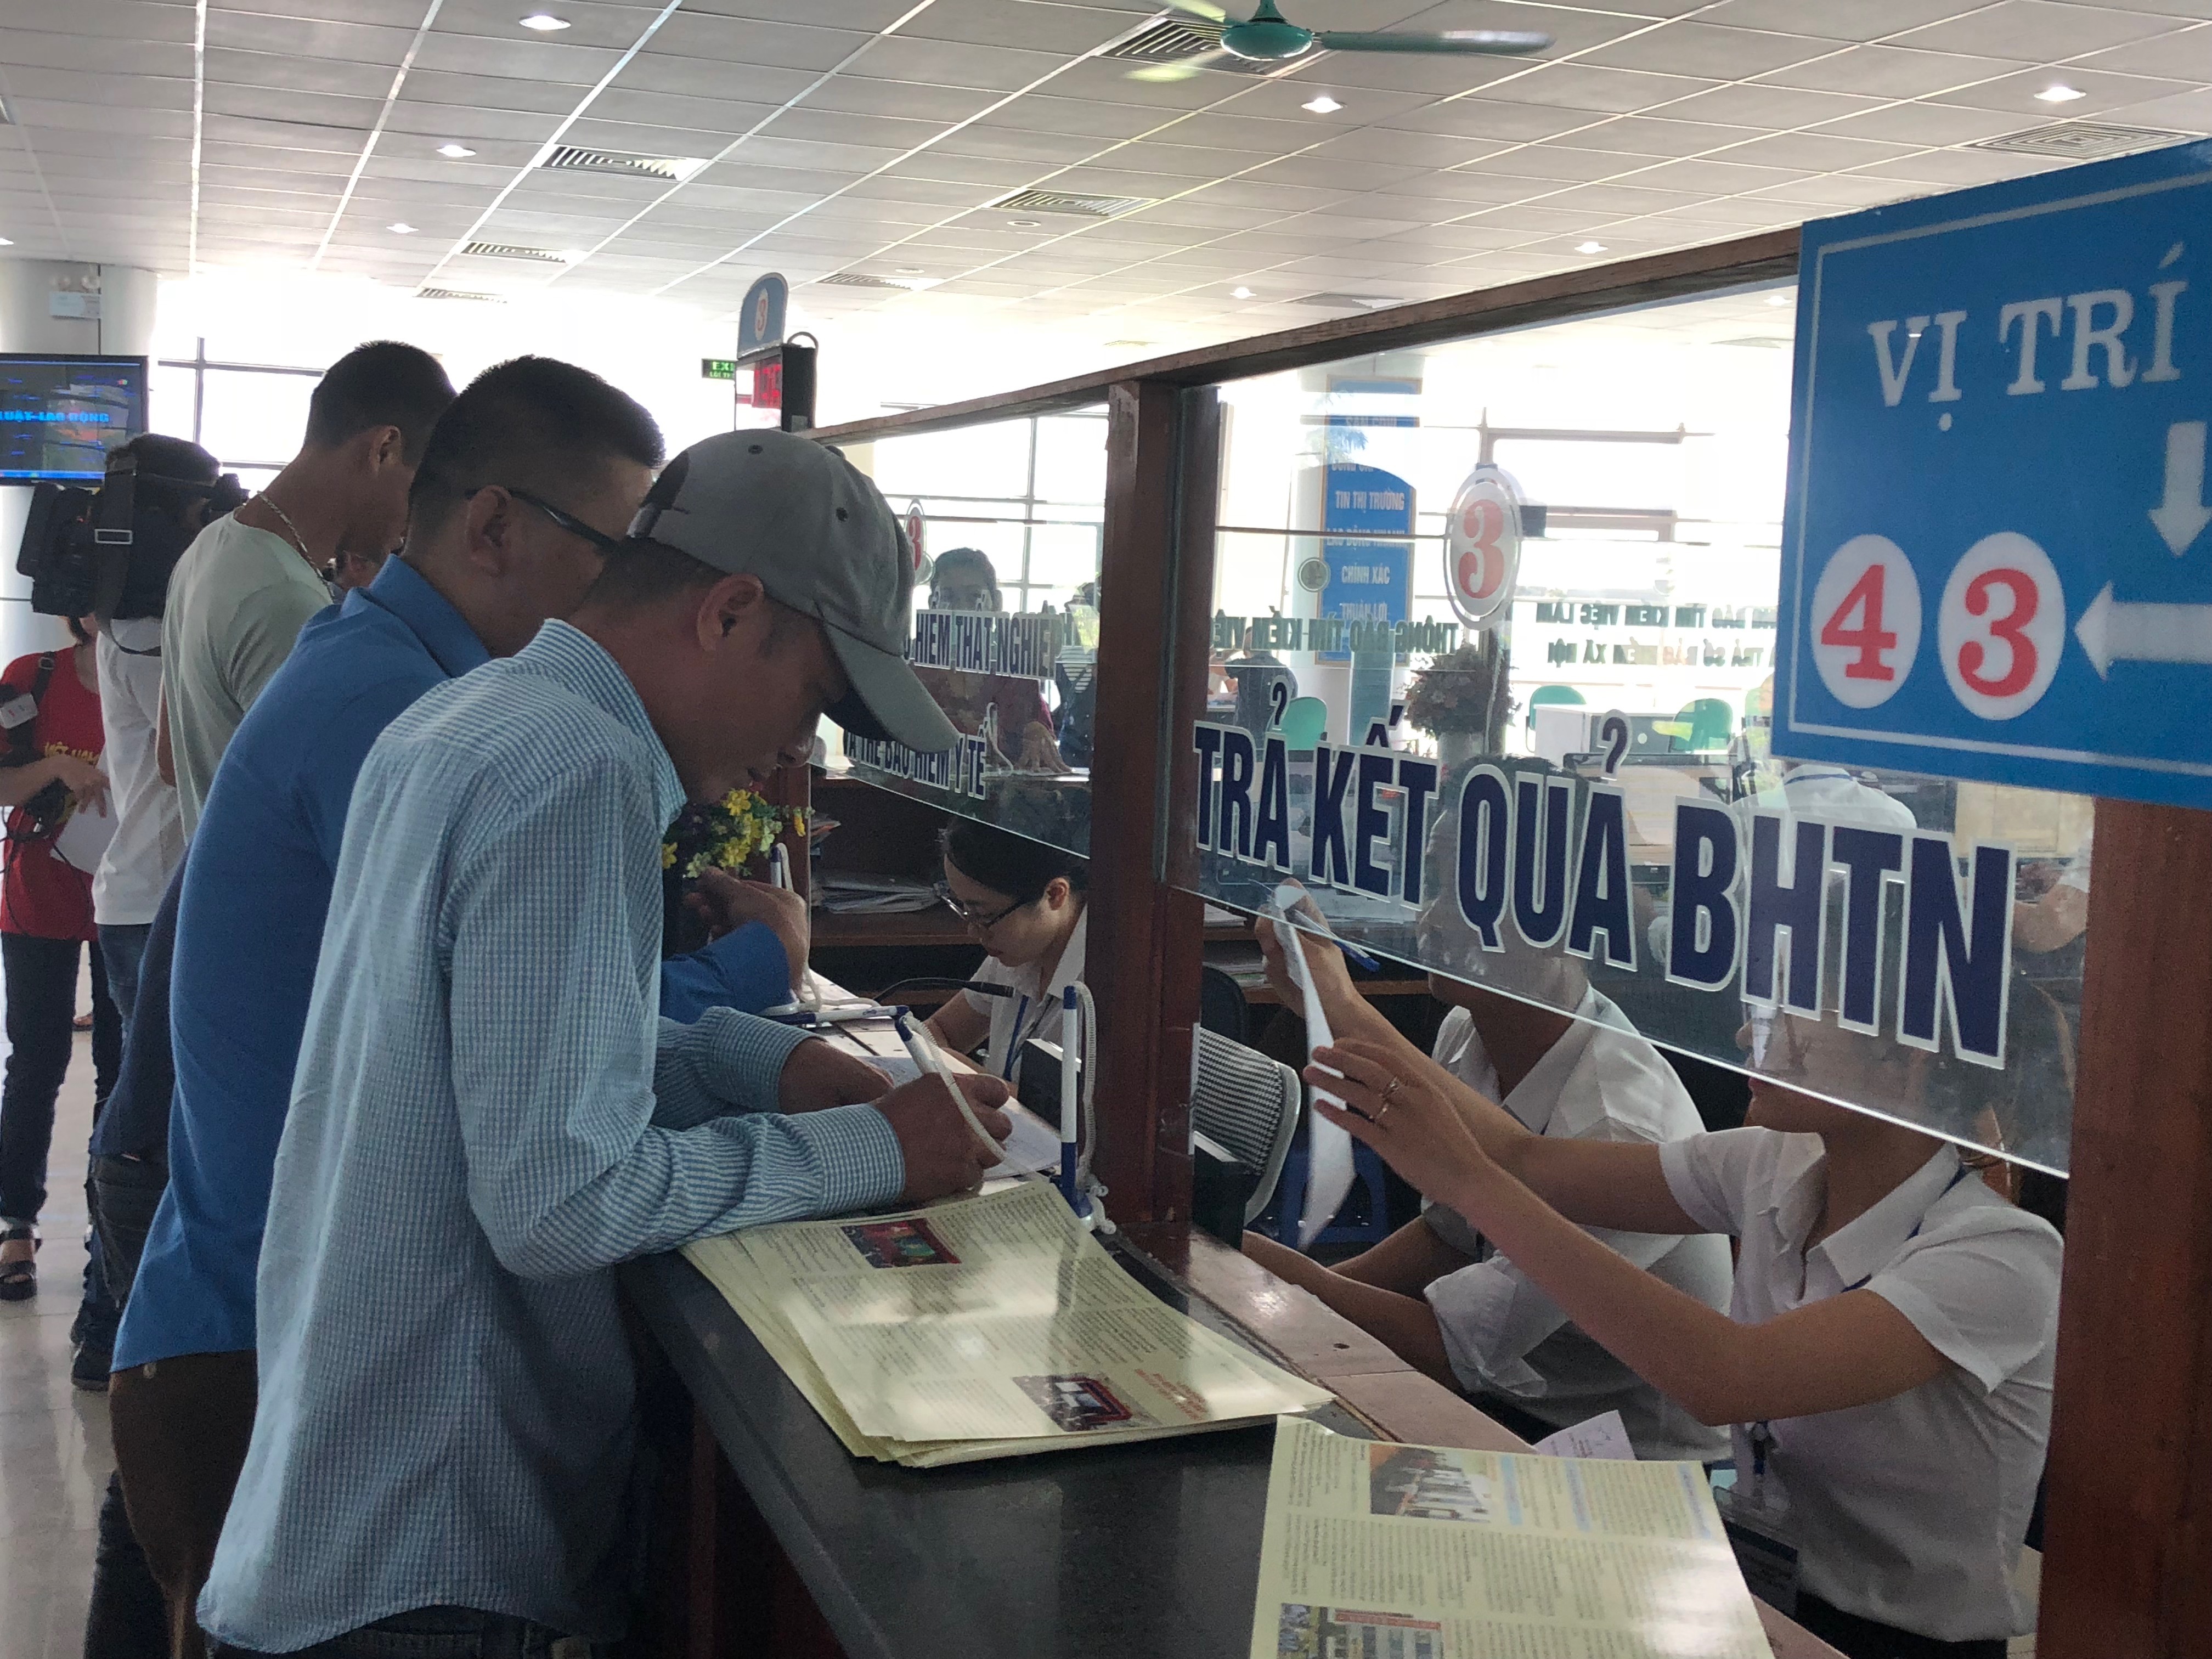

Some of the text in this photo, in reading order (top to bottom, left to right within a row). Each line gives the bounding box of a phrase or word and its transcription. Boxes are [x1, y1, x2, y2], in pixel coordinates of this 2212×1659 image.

[712, 361, 735, 371] EXI
[1867, 242, 2187, 432] VỊ TRÍ
[1335, 490, 1350, 509] TIN
[1353, 490, 1367, 514] THỊ
[1458, 499, 1504, 599] 3
[1341, 562, 1390, 585] CHÍNH XÁC
[1821, 564, 2039, 698] 4 3
[1193, 681, 2015, 1070] TRẢ KẾT QUẢ BHTN
